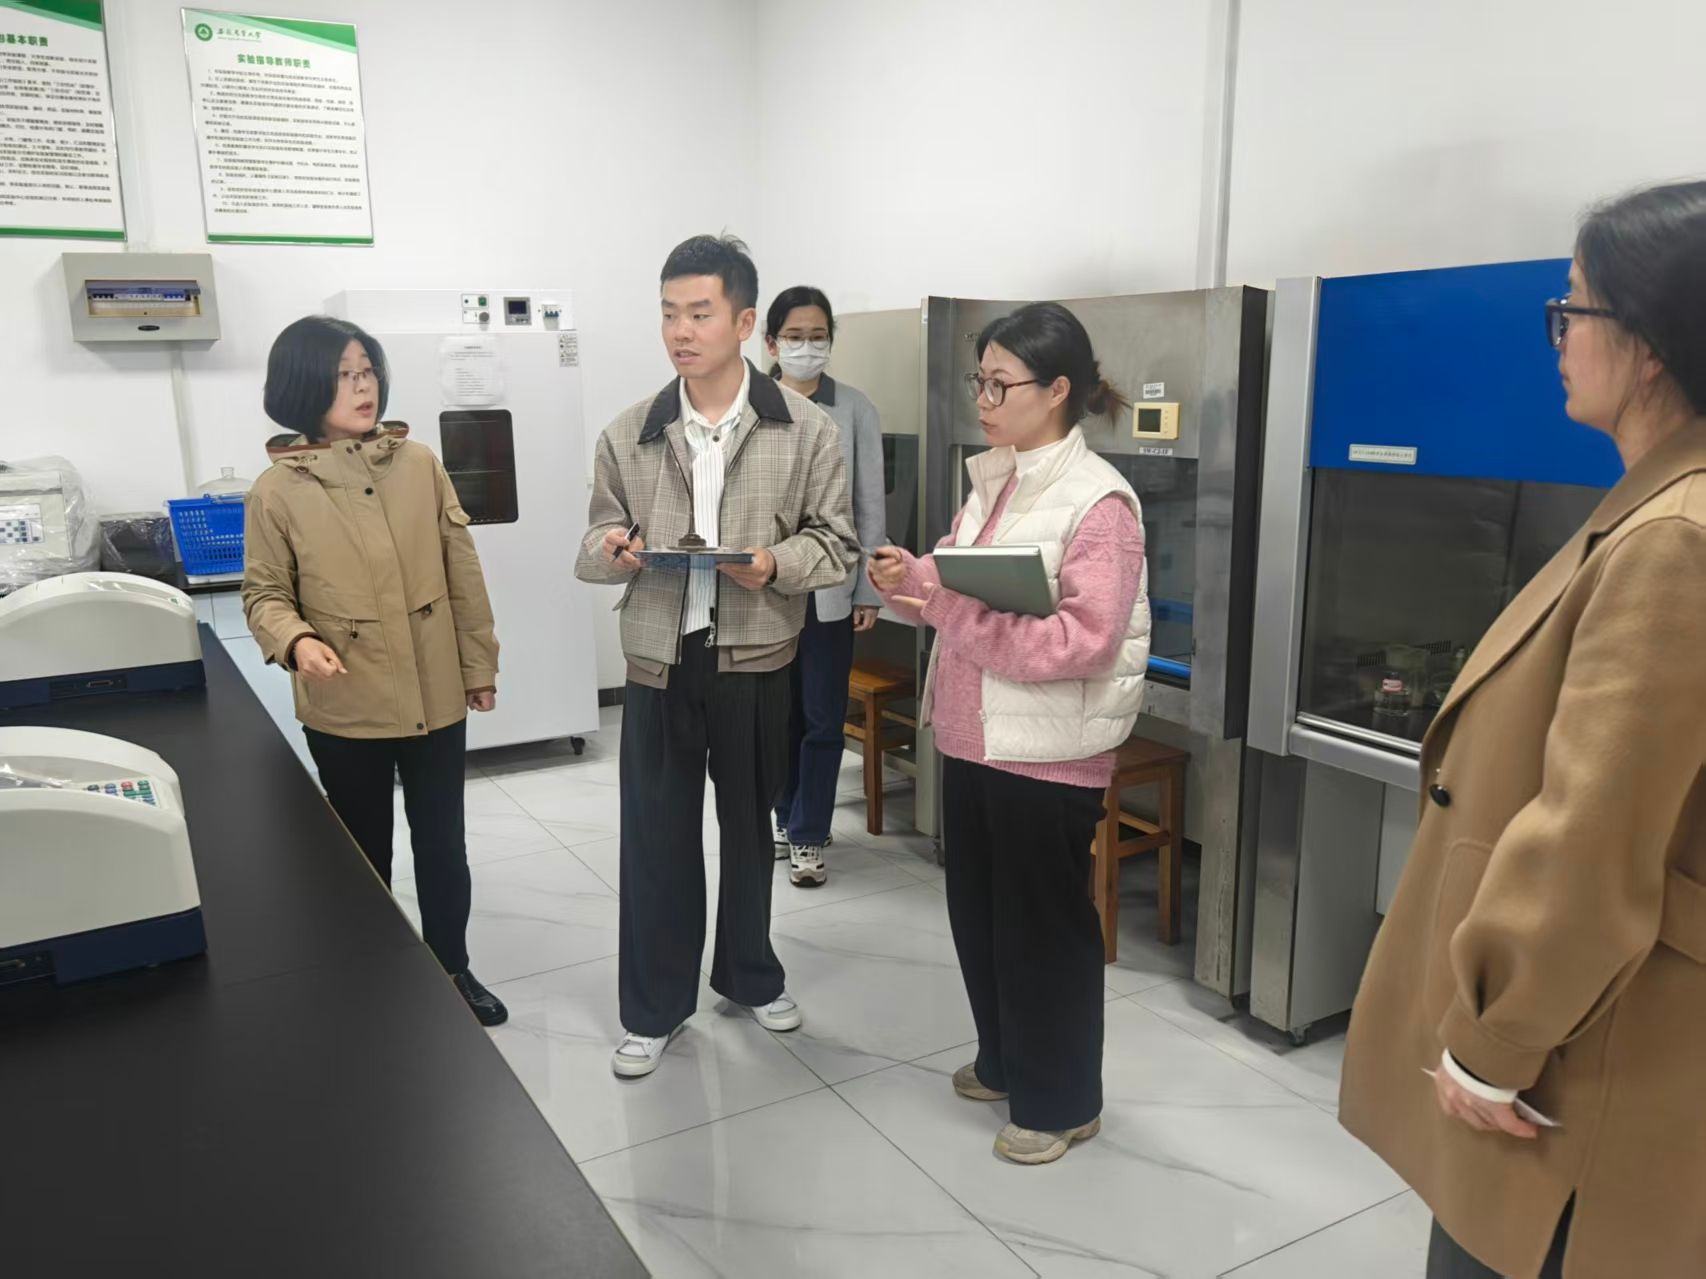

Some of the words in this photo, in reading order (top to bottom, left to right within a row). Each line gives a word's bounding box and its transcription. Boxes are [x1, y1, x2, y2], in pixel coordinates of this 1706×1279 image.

[237, 54, 311, 68] 实验指导教师职责
